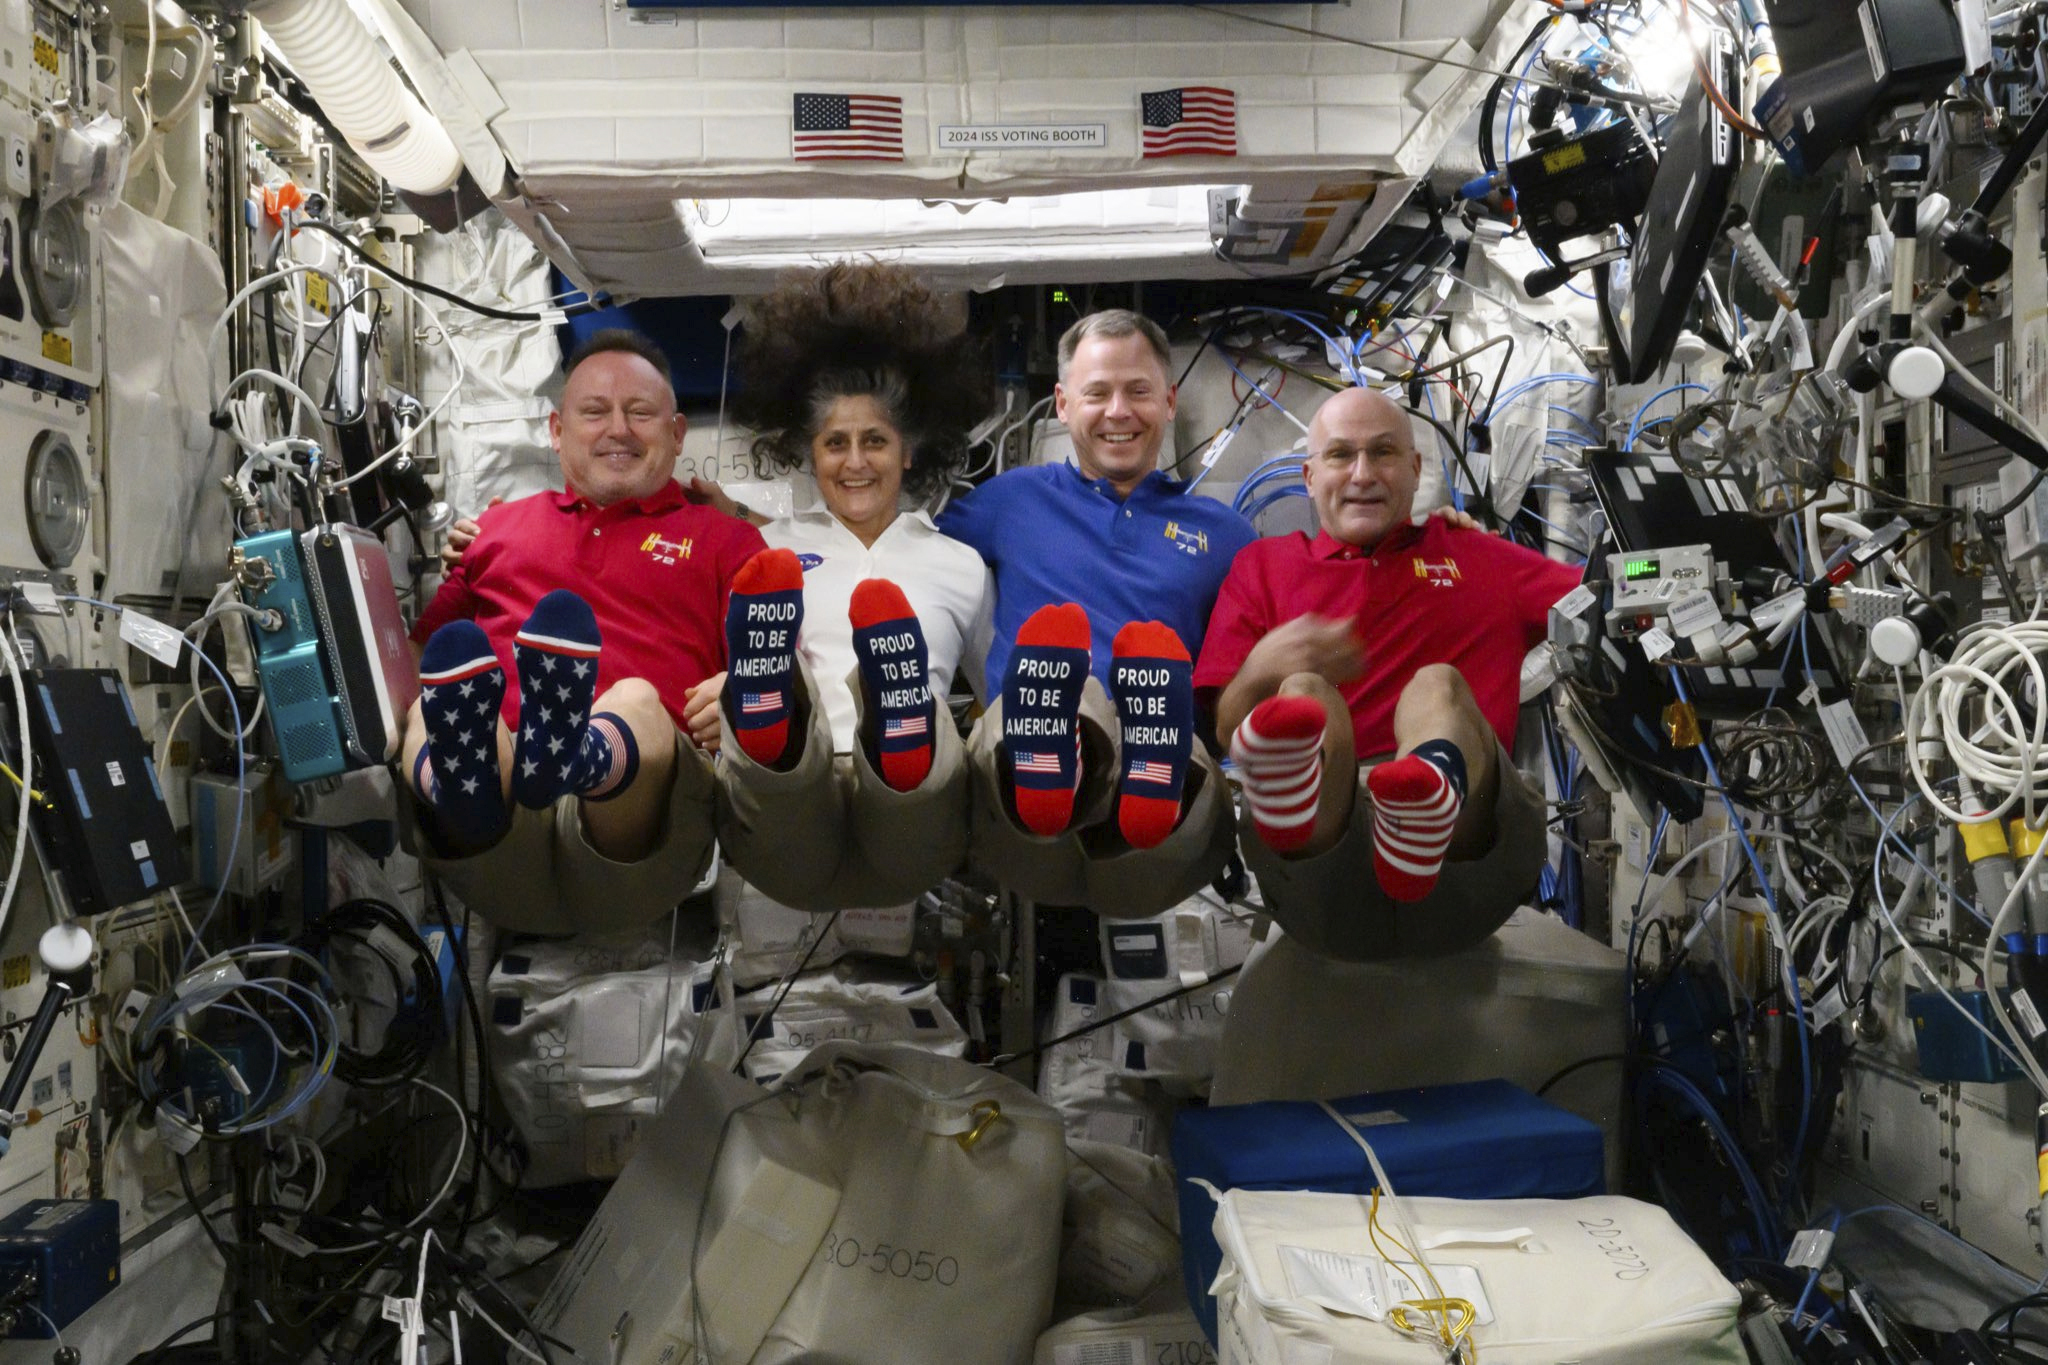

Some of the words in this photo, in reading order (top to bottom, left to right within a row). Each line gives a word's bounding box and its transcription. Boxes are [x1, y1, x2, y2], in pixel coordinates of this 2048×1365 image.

[948, 131, 977, 142] 2024
[981, 131, 998, 142] ISS
[1002, 131, 1049, 142] VOTING
[1052, 130, 1096, 142] BOOTH
[1176, 541, 1197, 555] 72
[652, 552, 675, 566] 72
[1430, 579, 1454, 587] 72
[748, 603, 796, 622] PROUD
[748, 631, 765, 649] TO
[768, 630, 788, 648] BE
[869, 632, 916, 656] PROUD
[734, 654, 791, 677] AMERICAN
[881, 663, 898, 681] TO
[900, 659, 920, 679] BE
[1017, 658, 1070, 679] PROUD
[1117, 667, 1170, 687] PROUD
[1019, 687, 1036, 706] TO
[1041, 689, 1061, 708] BE
[1125, 697, 1143, 715] TO
[1147, 696, 1166, 716] BE
[1006, 718, 1068, 736] AMERICAN
[1124, 726, 1178, 746] AMERICAN
